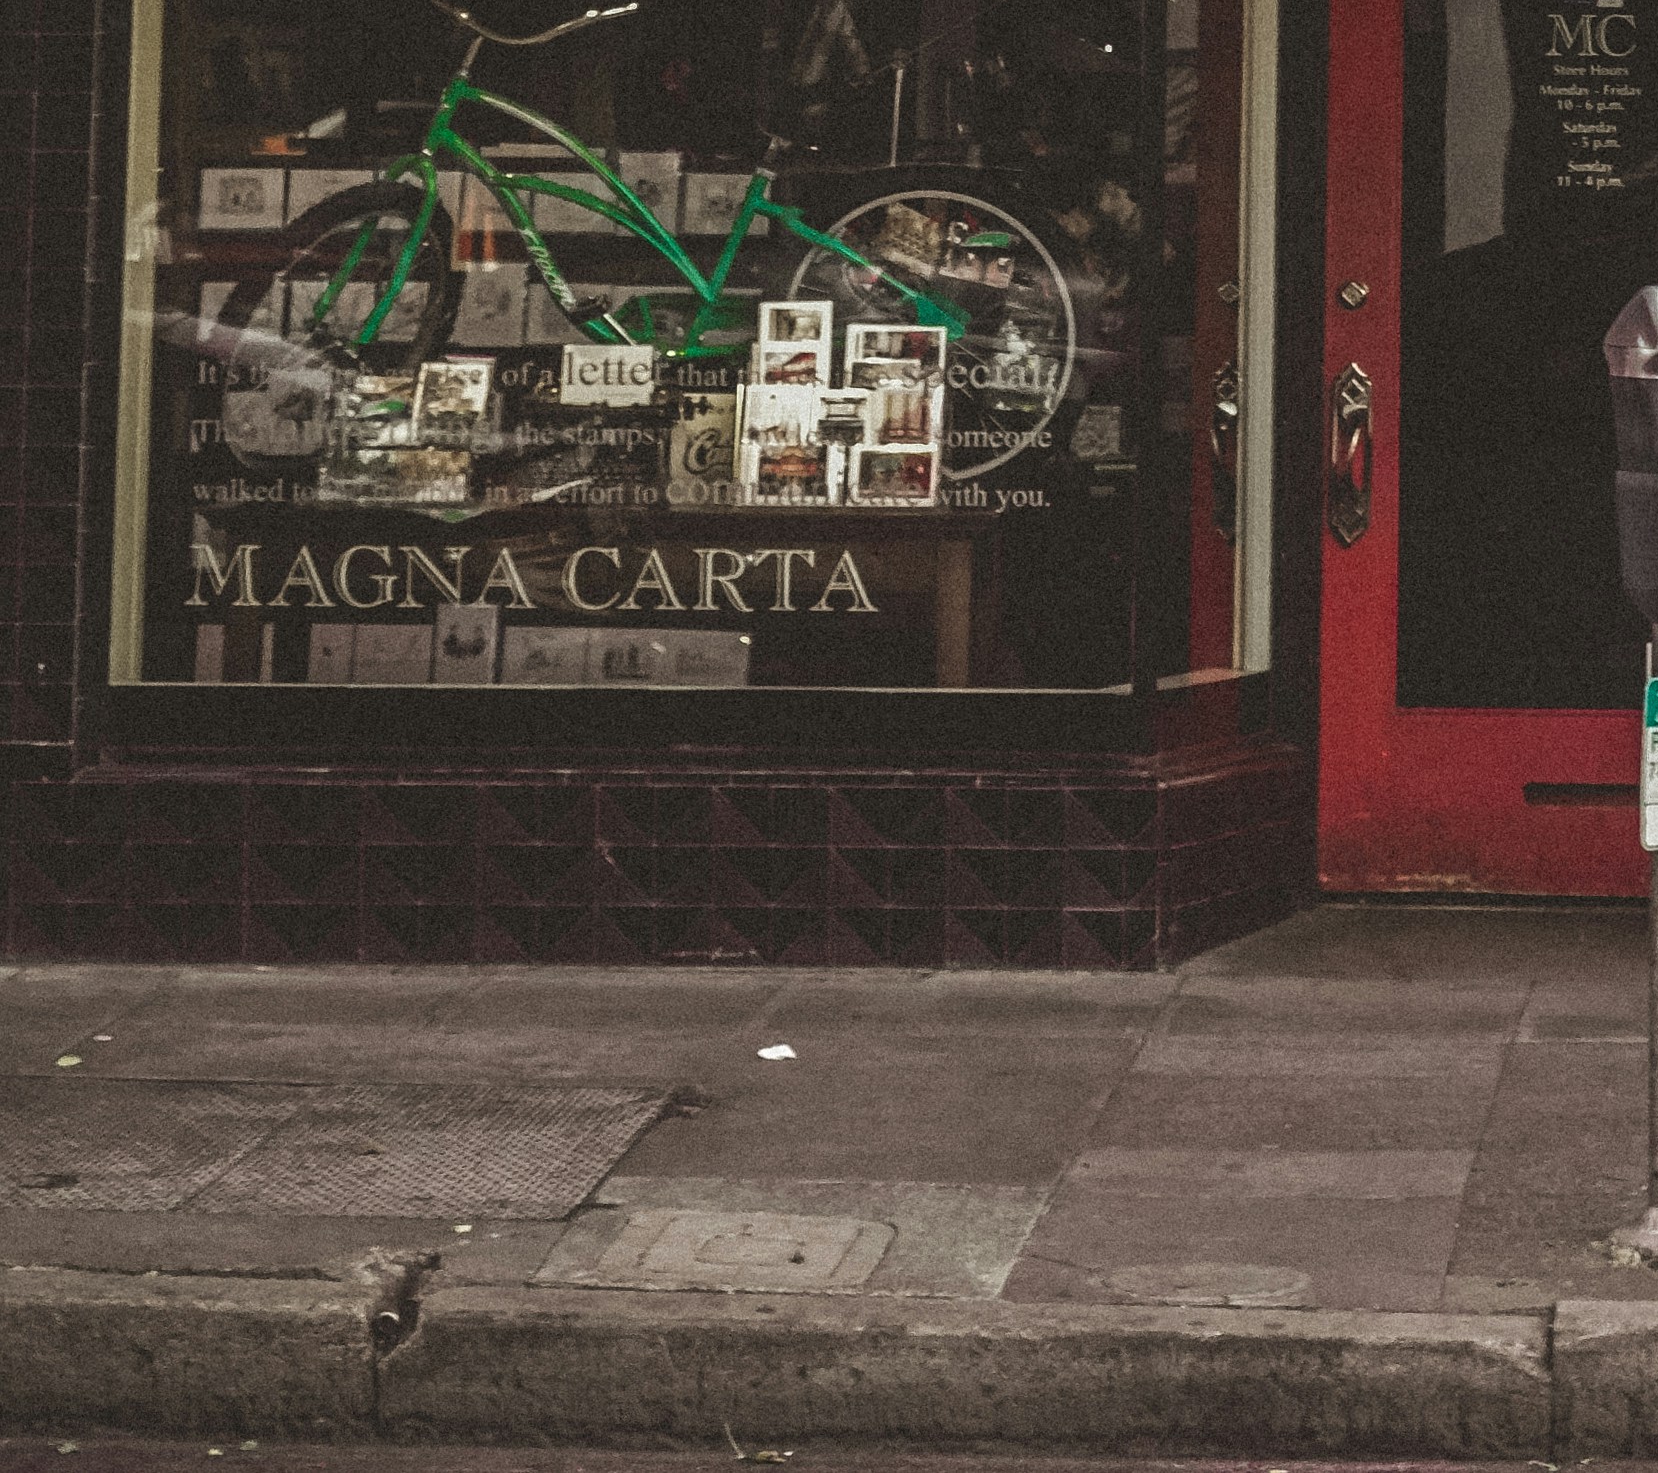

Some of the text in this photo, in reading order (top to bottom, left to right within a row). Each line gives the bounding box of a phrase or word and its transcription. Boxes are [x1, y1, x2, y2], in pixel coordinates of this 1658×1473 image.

[1545, 13, 1637, 57] MC
[1553, 64, 1630, 76] Store Hours
[1540, 84, 1590, 97] Monday
[1603, 84, 1641, 97] Friday
[1562, 122, 1617, 136] Saturday
[1567, 160, 1614, 176] Sunday
[501, 360, 534, 386] of
[539, 365, 556, 385] a
[565, 348, 669, 388] letter
[675, 362, 729, 388] that
[193, 478, 281, 502] walked
[556, 483, 624, 505] effort
[639, 482, 659, 504] to
[994, 489, 1052, 514] you.
[184, 544, 881, 613] MAGNA CARTA
